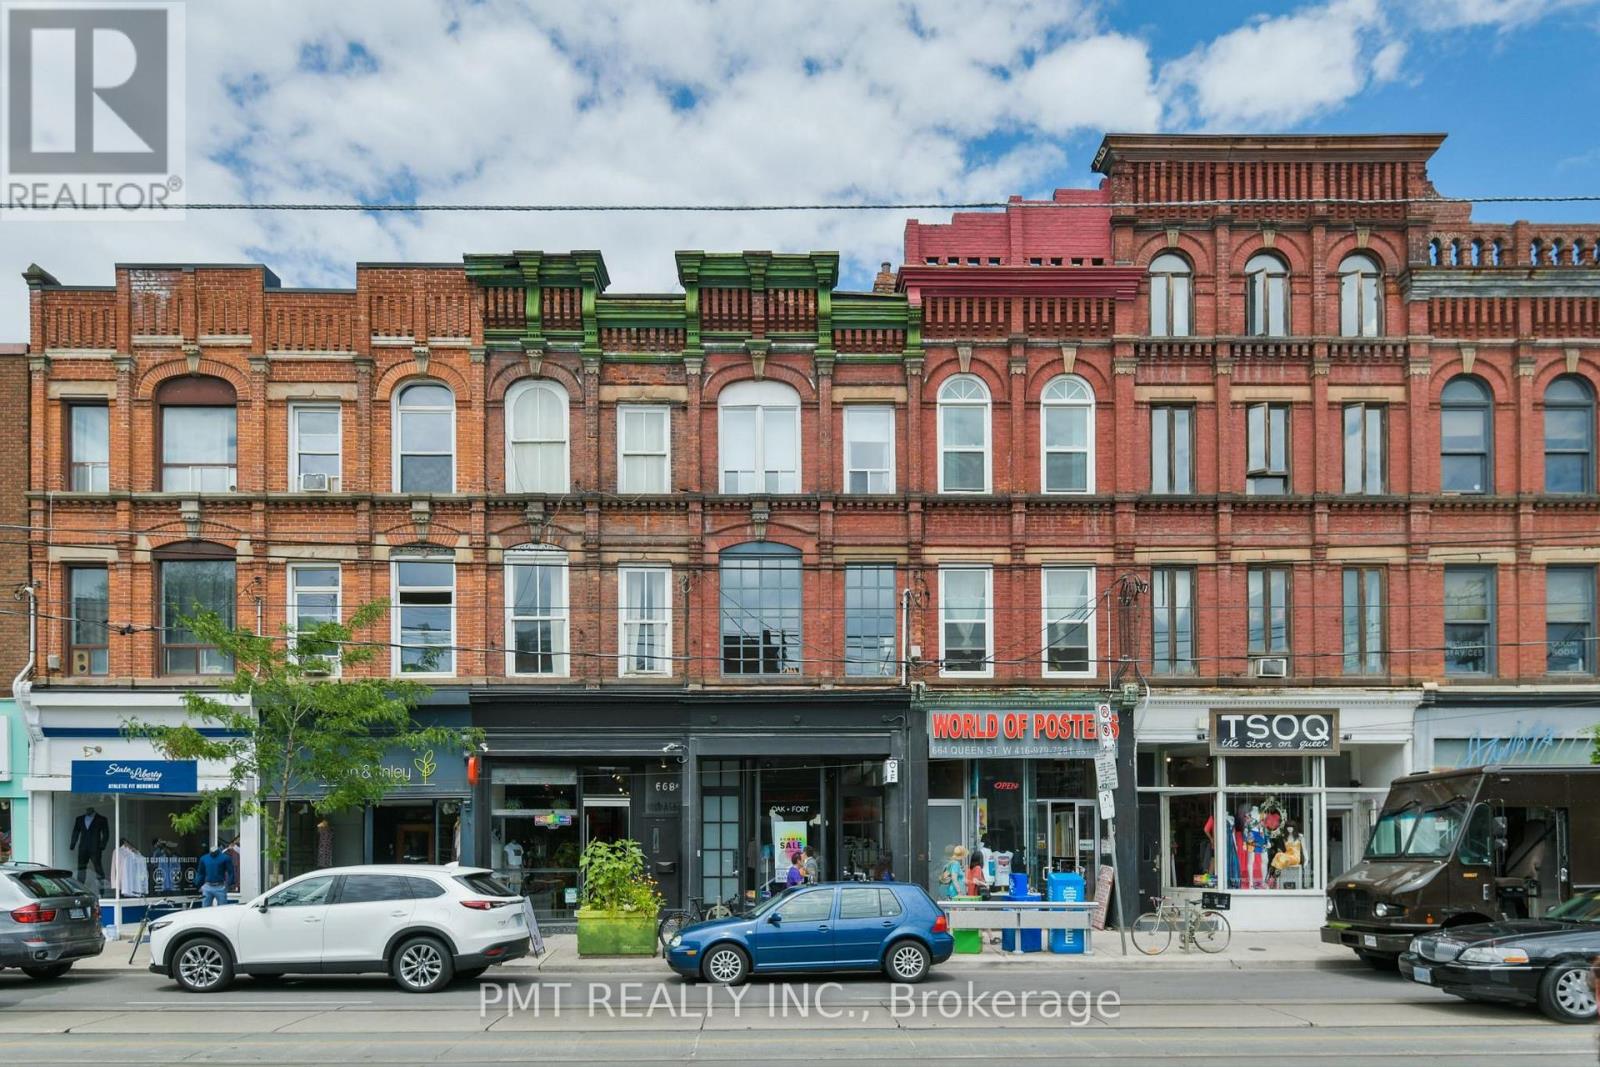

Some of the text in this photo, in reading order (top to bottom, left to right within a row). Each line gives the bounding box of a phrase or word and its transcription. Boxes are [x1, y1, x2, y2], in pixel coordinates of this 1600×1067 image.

[932, 712, 1120, 740] WORLD OF POSTES
[1221, 714, 1330, 741] TSOQ
[1221, 737, 1240, 748] the
[1245, 738, 1273, 749] store
[950, 746, 984, 755] QUEEN
[1002, 746, 1012, 755] W
[105, 763, 131, 775] State
[131, 767, 163, 781] Liberty
[374, 762, 412, 781] nley
[993, 781, 1019, 790] OPEN
[771, 805, 786, 813] OAK
[791, 805, 810, 813] FORT
[780, 841, 803, 850] SALE
